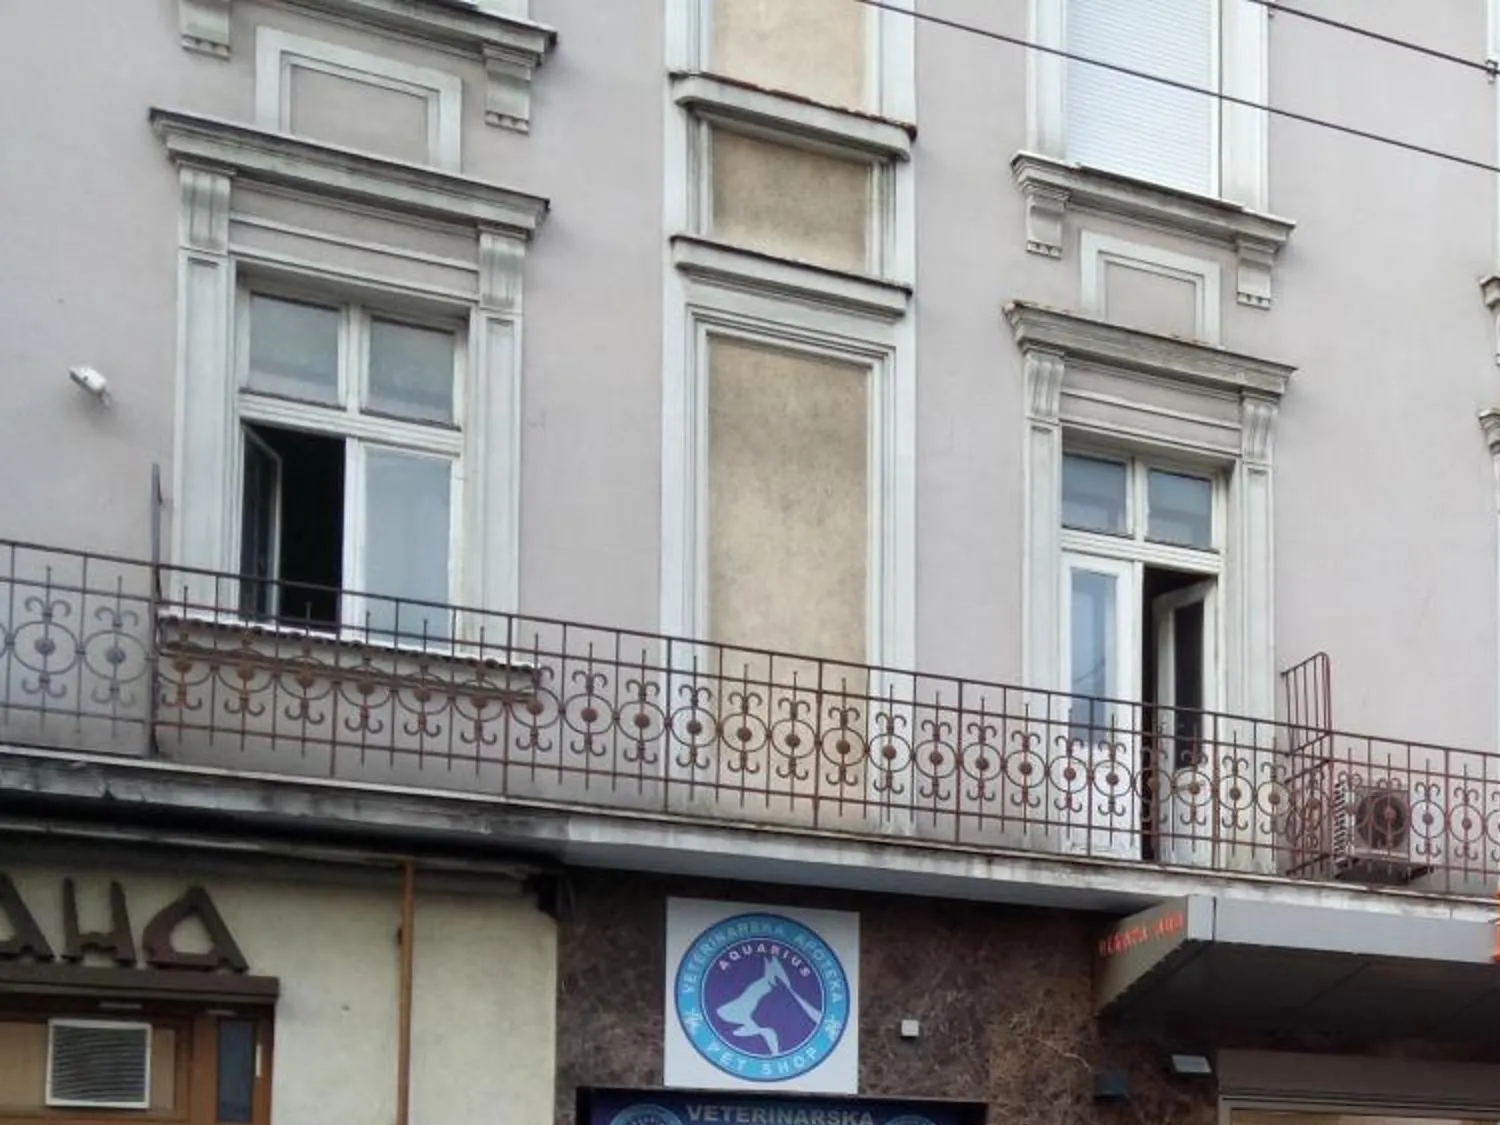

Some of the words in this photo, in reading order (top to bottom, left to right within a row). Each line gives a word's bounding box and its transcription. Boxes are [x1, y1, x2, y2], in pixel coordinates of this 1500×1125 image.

[681, 917, 785, 994] VETERINARSKA
[792, 933, 843, 1003] APOTEKA
[718, 943, 811, 977] AQUARIUS
[706, 1040, 748, 1072] PET
[762, 1047, 818, 1076] SHOP
